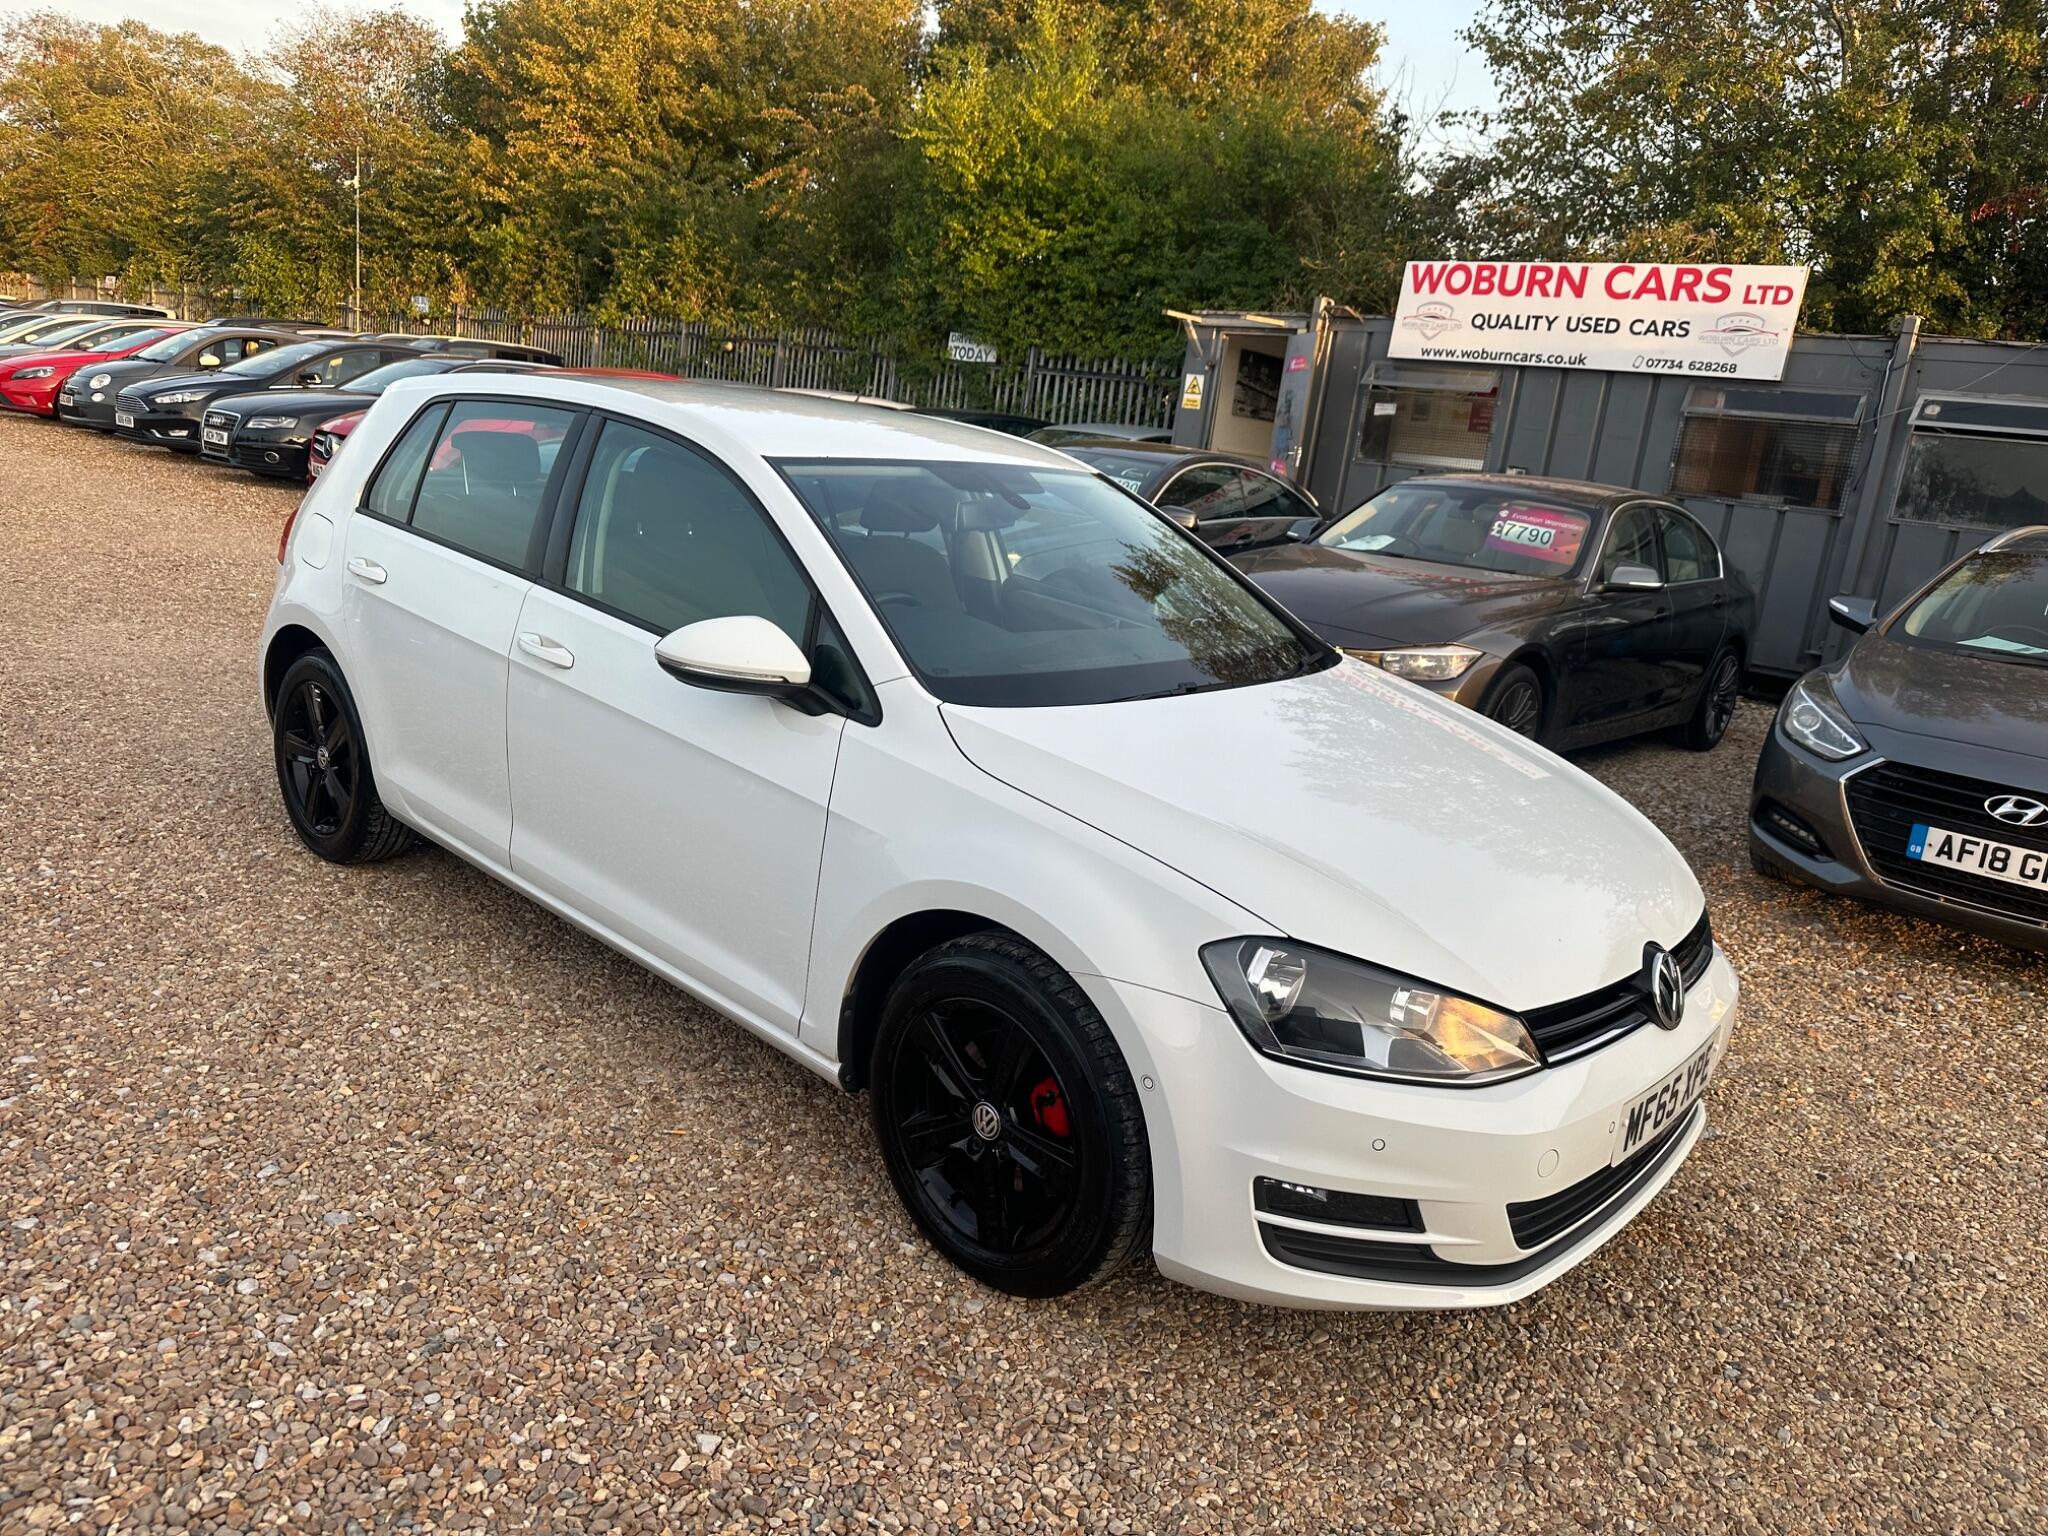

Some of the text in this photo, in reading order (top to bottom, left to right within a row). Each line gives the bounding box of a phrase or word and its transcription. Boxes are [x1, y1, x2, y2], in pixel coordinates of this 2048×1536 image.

[1411, 263, 1794, 306] WOBURN CARS LTD
[1471, 313, 1690, 338] QUALITY USED CARS
[1698, 334, 1736, 343] WOBURN
[1737, 336, 1760, 344] CARS
[953, 345, 992, 362] TODAY
[1420, 347, 1587, 366] www.woburncars.co.uk
[1646, 358, 1738, 374] 07734 628268
[1910, 844, 1922, 853] GB
[1935, 834, 2011, 873] AF18
[1623, 1041, 1715, 1153] MF65 XPE
